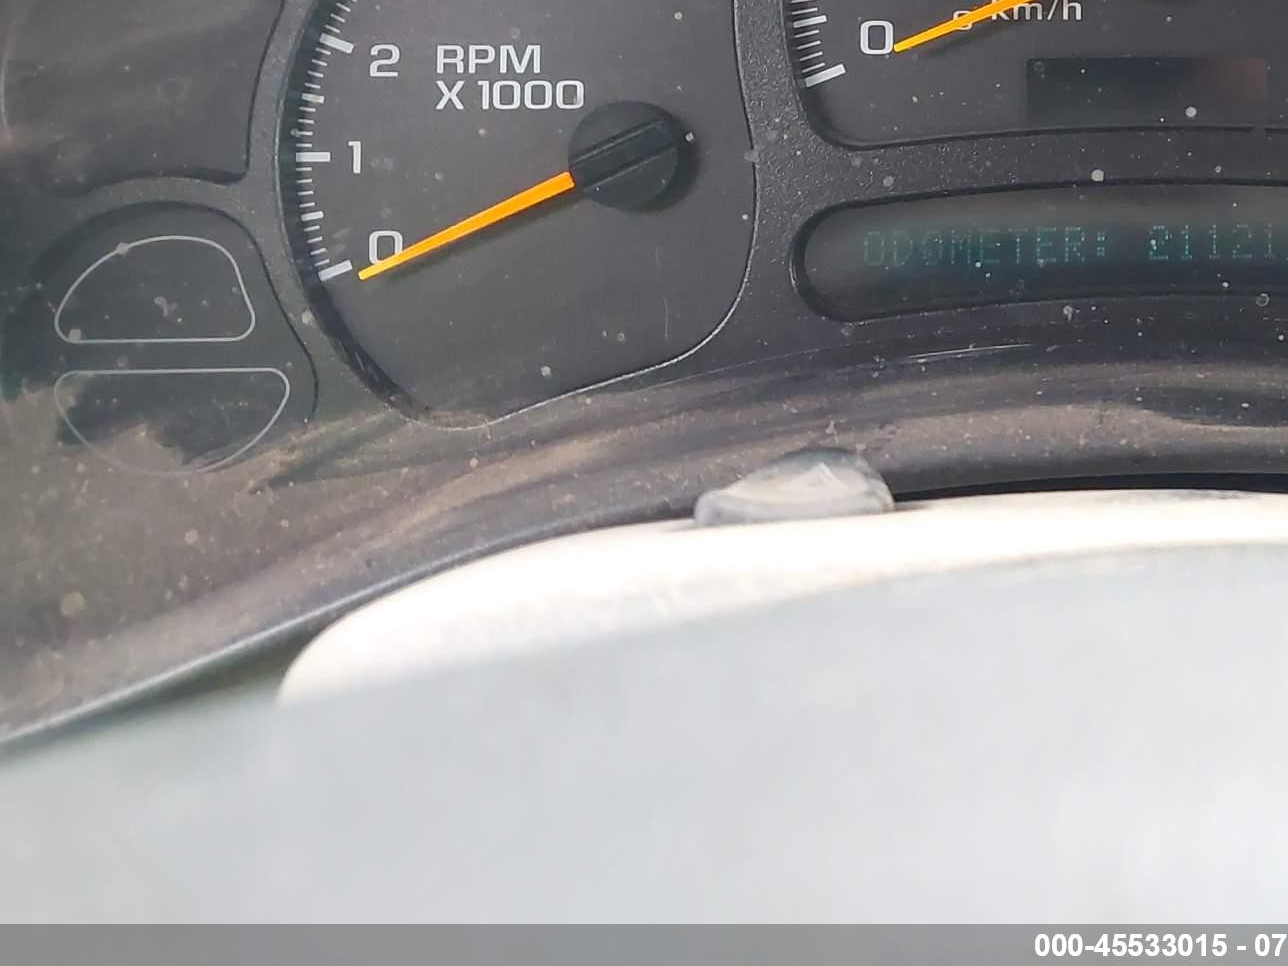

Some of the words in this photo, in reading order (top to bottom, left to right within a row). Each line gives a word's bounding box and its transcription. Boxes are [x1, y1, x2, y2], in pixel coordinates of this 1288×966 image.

[861, 21, 893, 54] 0
[370, 45, 399, 76] 2
[437, 45, 540, 73] RPM
[436, 81, 464, 109] X
[478, 81, 584, 109] 1000
[349, 141, 361, 173] 1
[369, 230, 404, 265] 0
